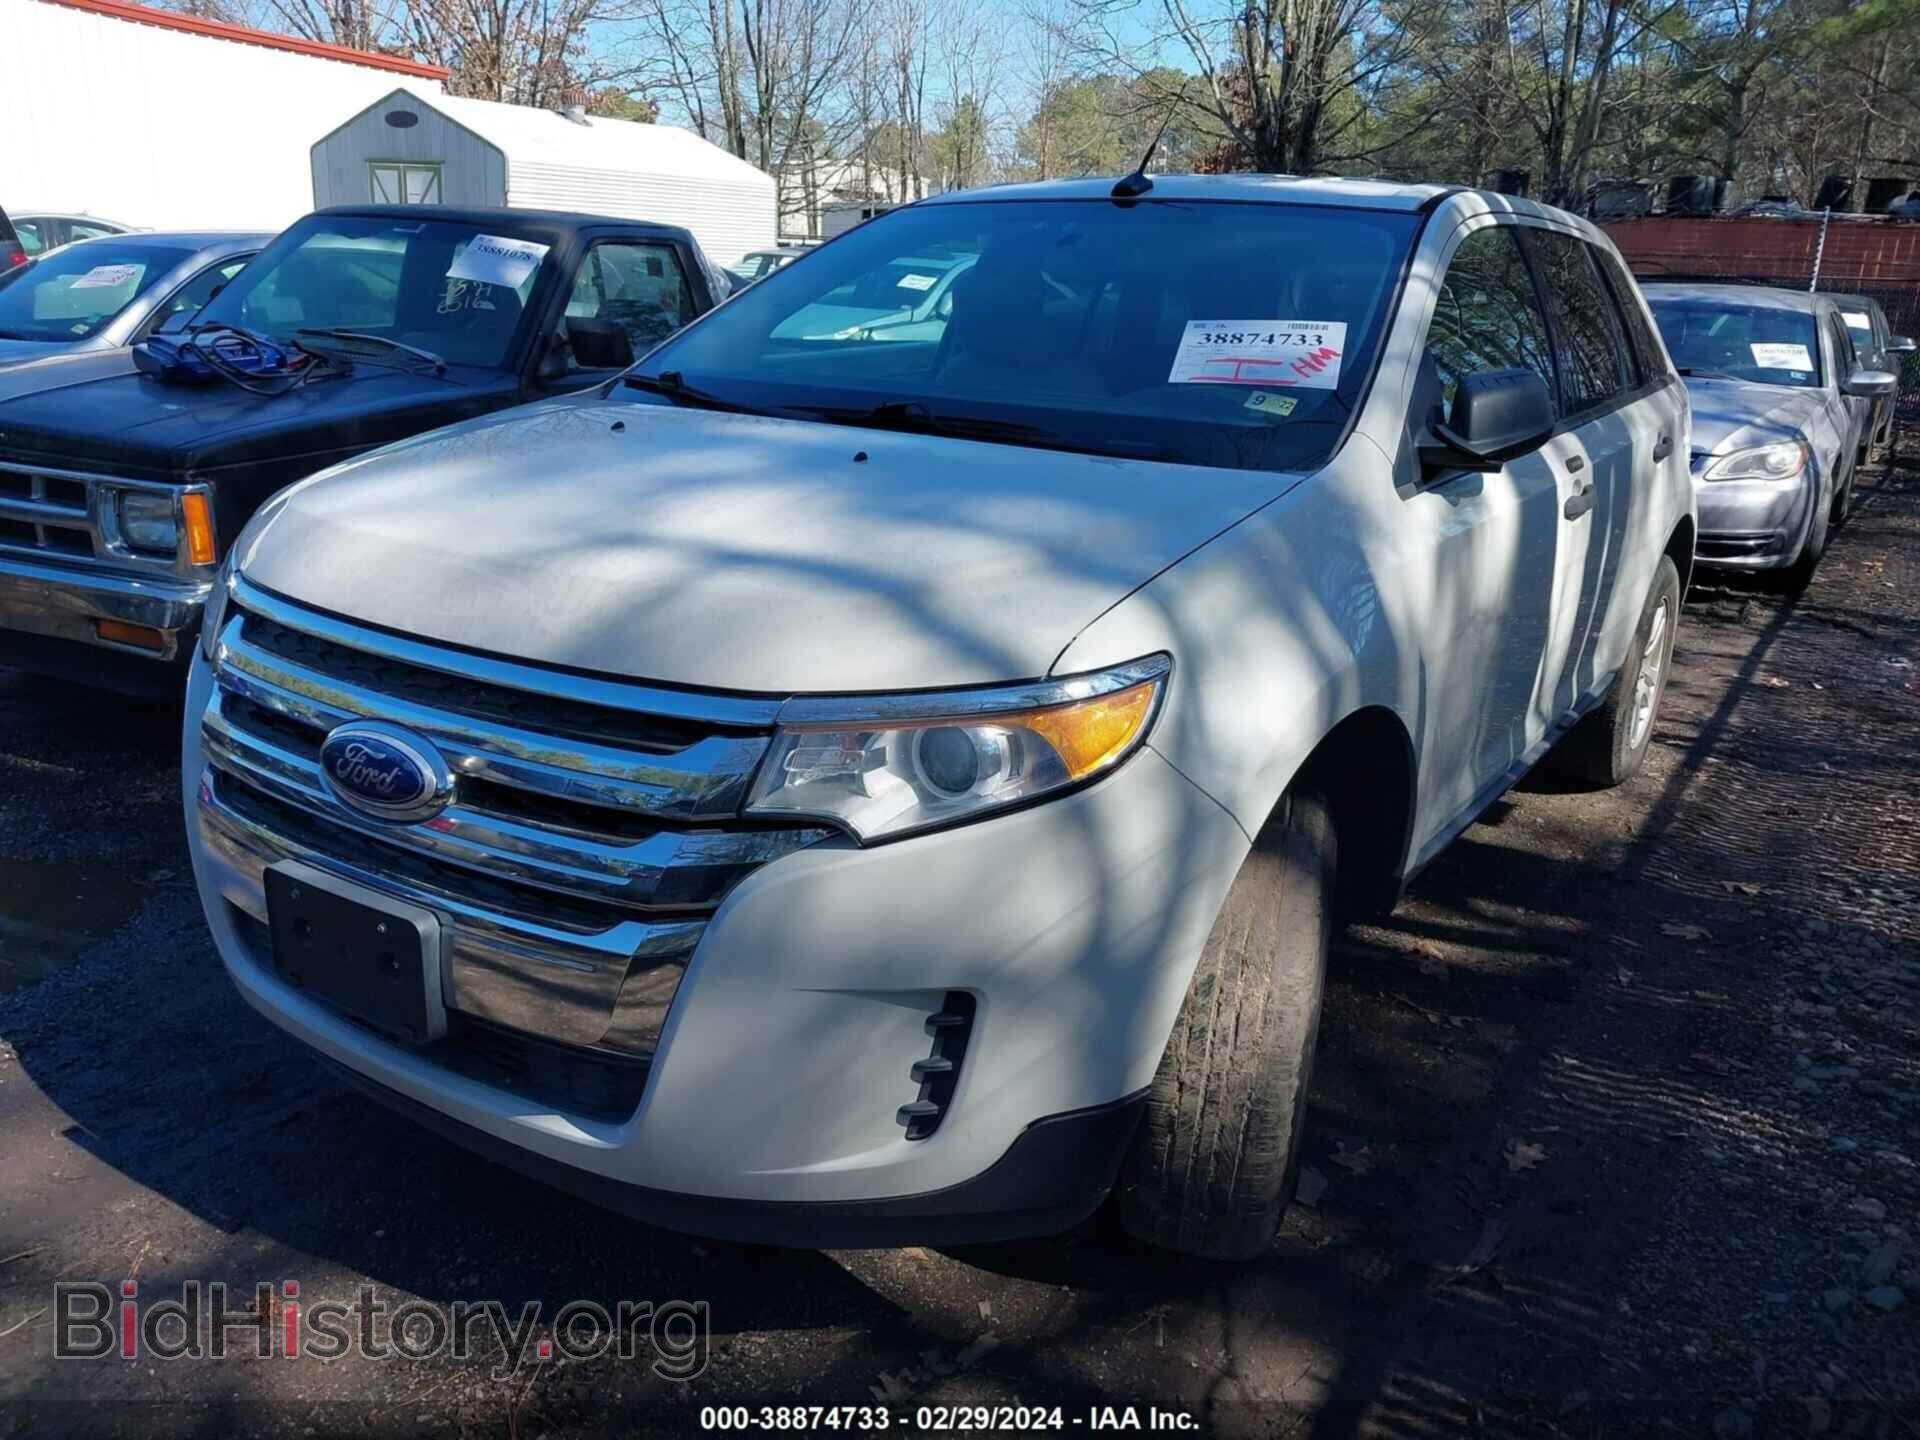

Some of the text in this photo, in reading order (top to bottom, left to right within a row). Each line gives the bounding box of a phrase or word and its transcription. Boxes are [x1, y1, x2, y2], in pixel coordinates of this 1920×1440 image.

[1197, 332, 1324, 347] 38874733
[1253, 395, 1266, 406] 9
[336, 742, 402, 793] Ford
